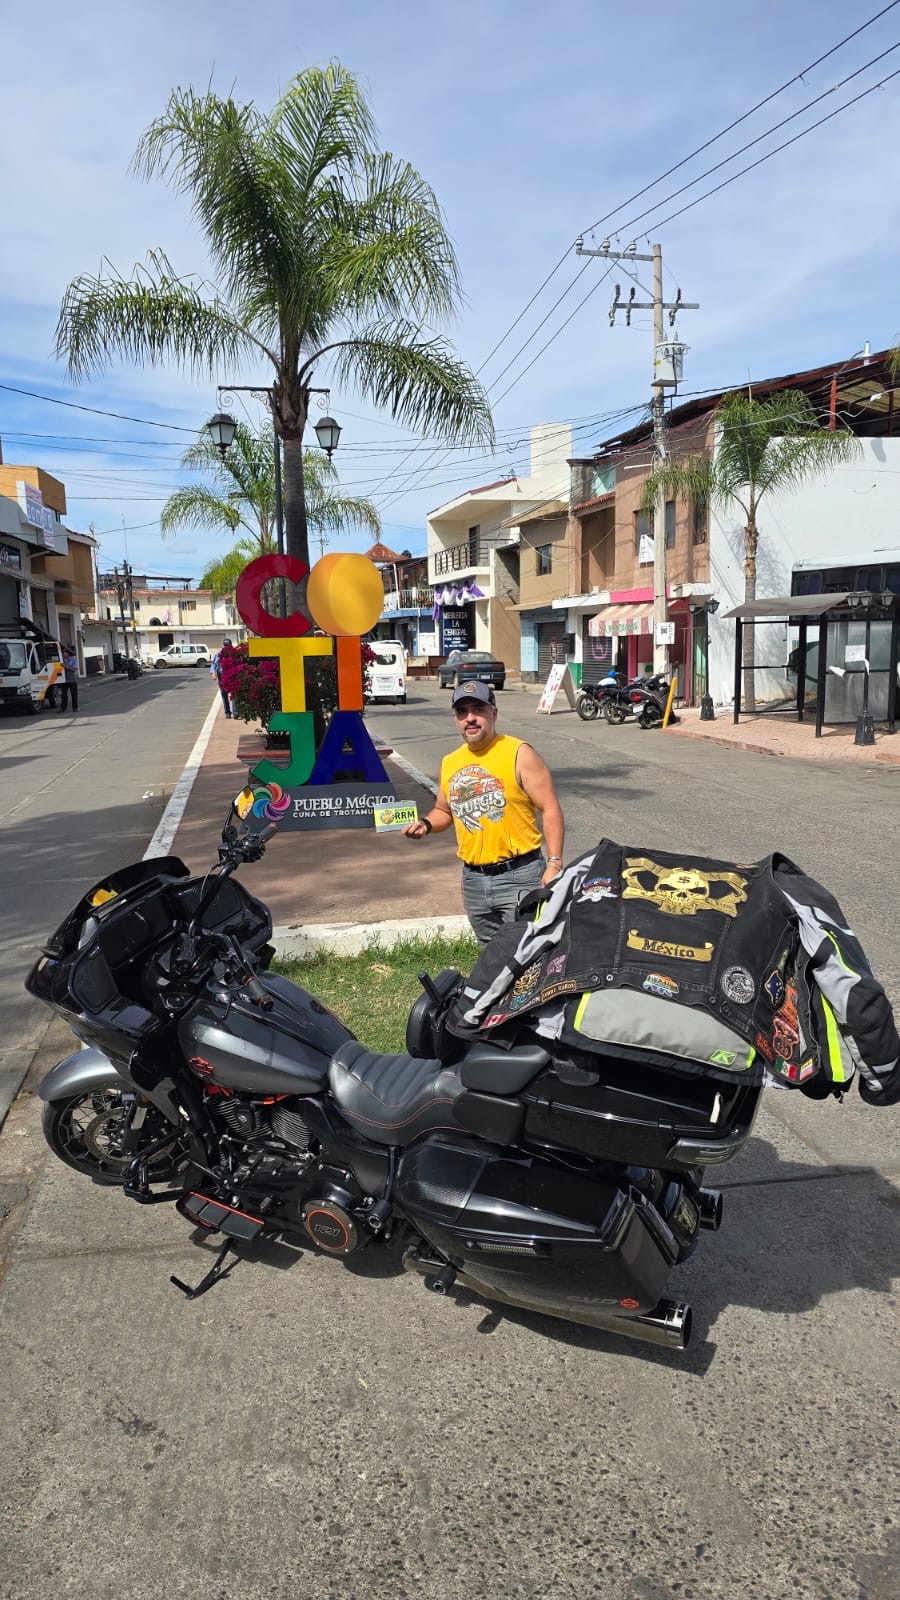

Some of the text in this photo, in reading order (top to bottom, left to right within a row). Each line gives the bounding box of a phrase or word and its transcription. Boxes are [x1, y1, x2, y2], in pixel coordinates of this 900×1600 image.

[451, 619, 460, 628] LA
[450, 790, 507, 818] STURGIS
[334, 808, 374, 817] TROTAMU
[394, 811, 415, 820] RRM
[642, 939, 695, 958] México
[314, 1223, 341, 1237] 121
